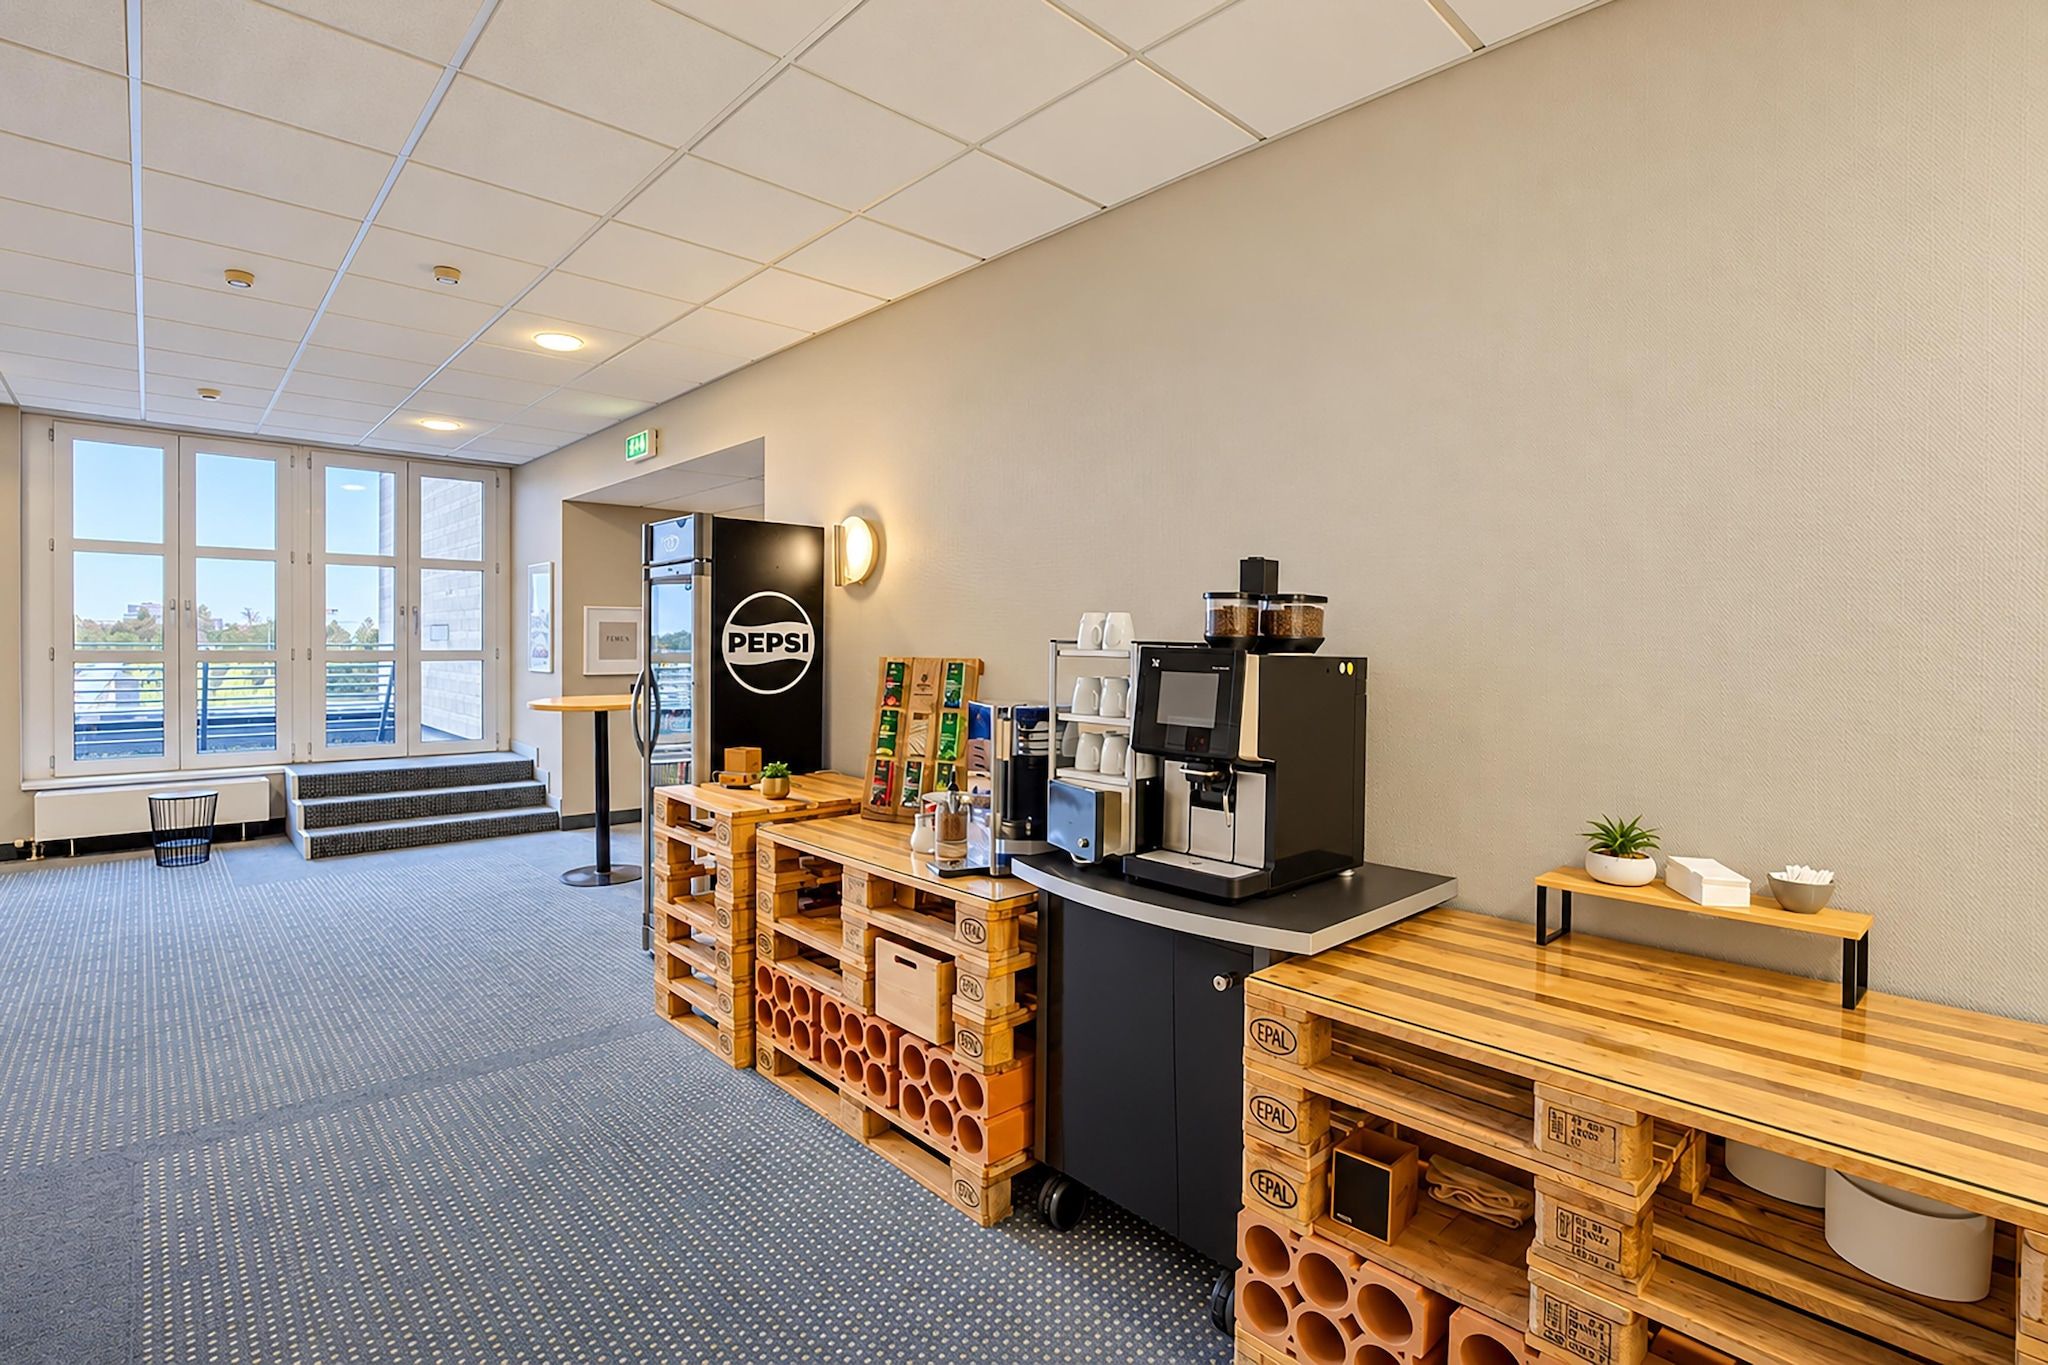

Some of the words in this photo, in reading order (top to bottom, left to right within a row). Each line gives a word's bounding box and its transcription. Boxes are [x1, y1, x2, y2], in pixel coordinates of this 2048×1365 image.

[728, 632, 809, 653] PEPSI
[1257, 1022, 1290, 1051] EPAL
[1257, 1100, 1290, 1130] EPAL
[1257, 1173, 1292, 1208] EPAL
